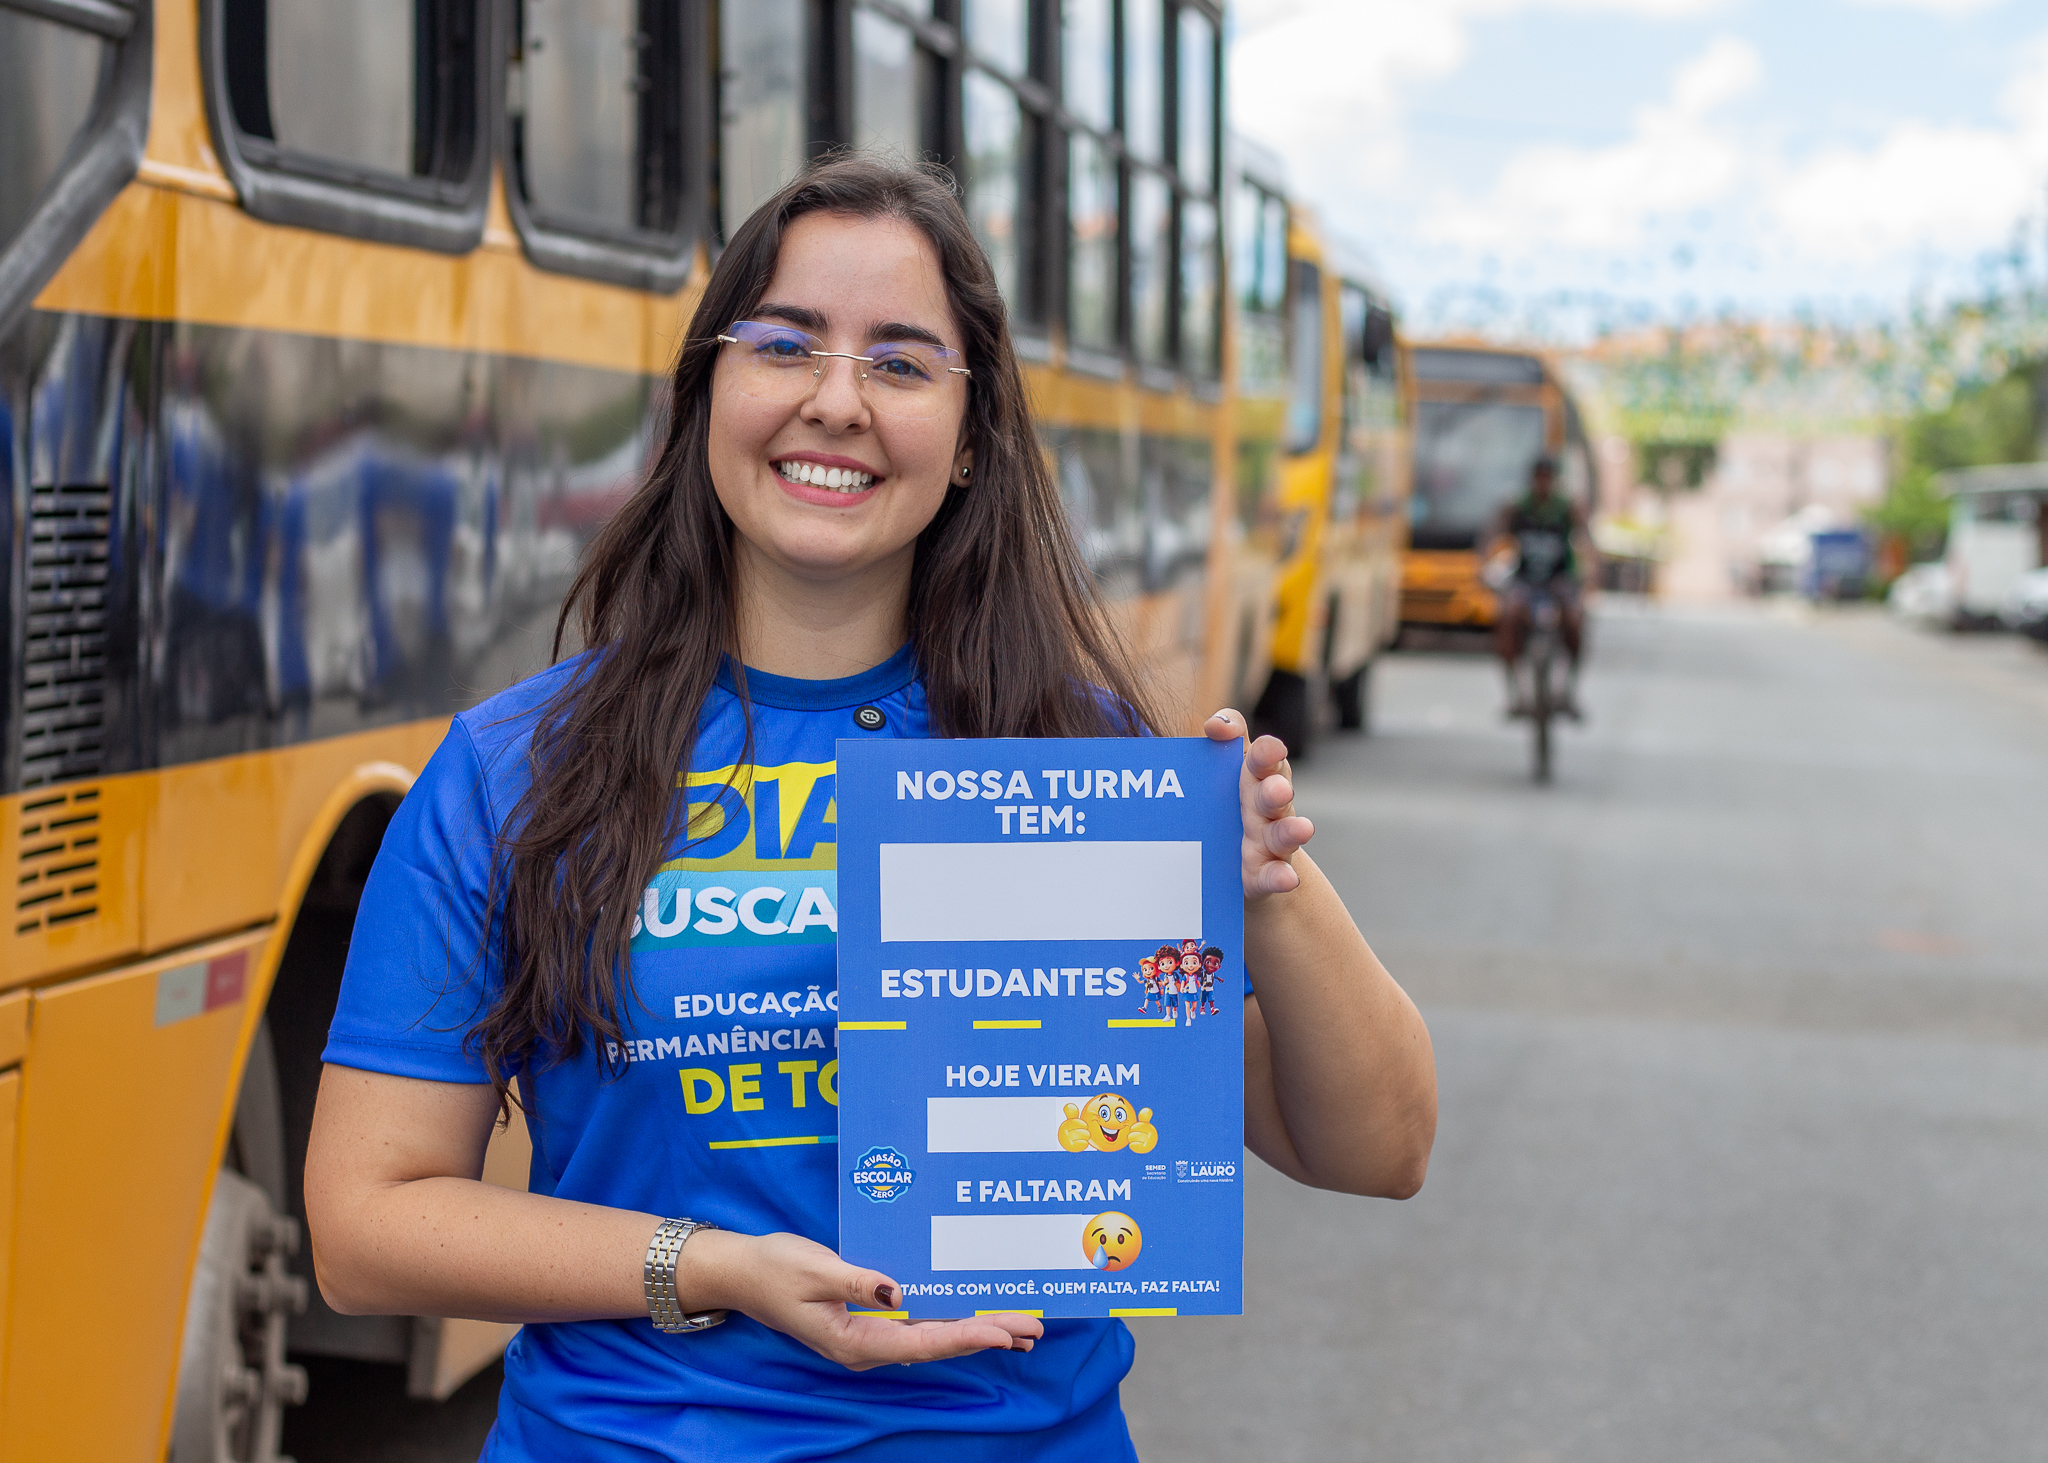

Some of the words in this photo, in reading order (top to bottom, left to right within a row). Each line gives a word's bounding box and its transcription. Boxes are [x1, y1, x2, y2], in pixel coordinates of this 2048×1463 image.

[897, 770, 1033, 800] NOSSA
[1042, 769, 1184, 799] TURMA
[995, 805, 1085, 834] TEM:
[882, 967, 1126, 998] ESTUDANTES
[606, 1025, 826, 1064] PERMANÊNCIA
[947, 1065, 1019, 1087] HOJE
[1027, 1064, 1139, 1086] VIERAM
[679, 1063, 765, 1115] DE
[863, 1152, 902, 1168] EVASÃO
[1190, 1165, 1236, 1176] LAURO
[853, 1171, 912, 1184] ESCOLAR
[870, 1189, 895, 1199] ZERO
[957, 1181, 971, 1202] E
[980, 1179, 1130, 1202] FALTARAM
[901, 1283, 954, 1297] TAMOS
[957, 1284, 990, 1295] COM
[995, 1280, 1039, 1294] VOCÊ.
[1043, 1283, 1085, 1296] QUEM
[1090, 1282, 1137, 1294] FALTA,
[1142, 1281, 1168, 1292] FAZ
[1172, 1281, 1219, 1292] FALTA!
